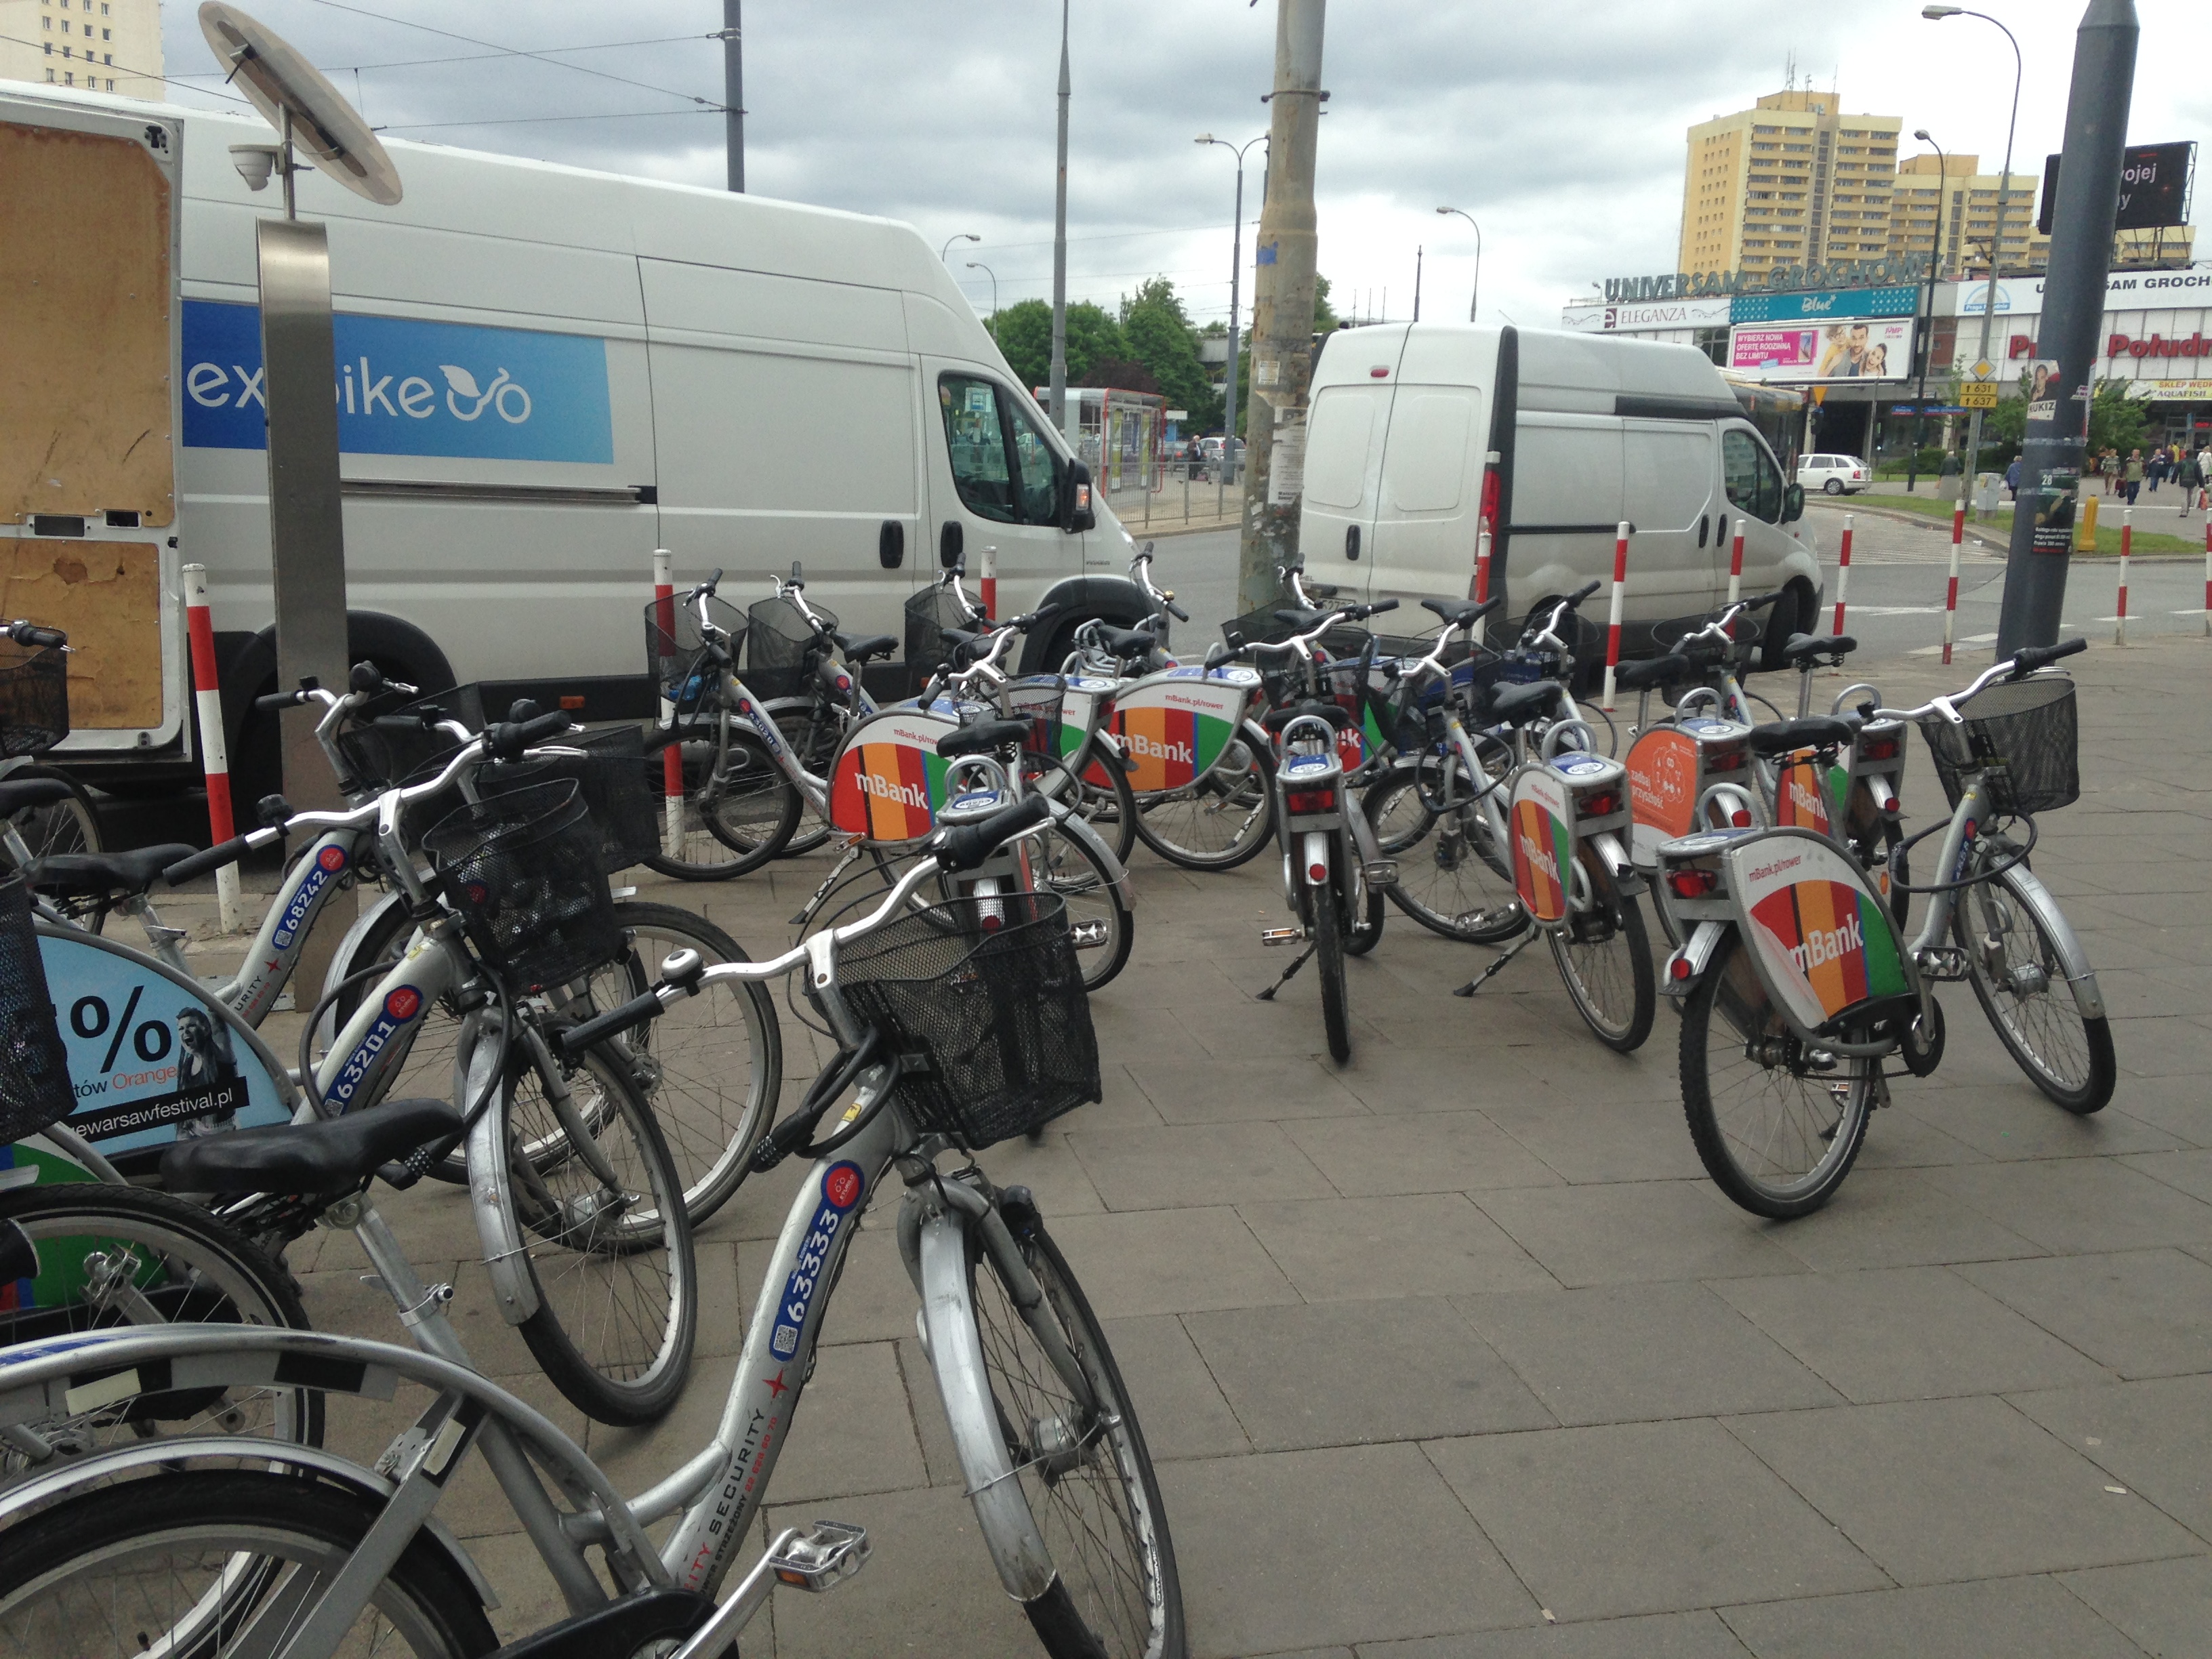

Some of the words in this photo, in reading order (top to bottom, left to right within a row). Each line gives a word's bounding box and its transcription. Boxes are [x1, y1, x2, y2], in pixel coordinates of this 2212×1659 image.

[1605, 270, 1748, 302] UNIVERSAM
[1621, 308, 1687, 323] ELEGANZA
[2042, 474, 2053, 485] 28
[1165, 695, 1224, 710] mBank.pl/rower
[1111, 733, 1193, 764] mBank
[855, 772, 929, 810] mBank
[1520, 834, 1561, 884] mBank
[1749, 855, 1801, 882] mBank.pl/rower
[285, 871, 327, 930] 68242
[1790, 913, 1863, 971] mBank
[234, 976, 262, 1010] URITY
[337, 1021, 396, 1098] 63201
[112, 1066, 178, 1090] Orange
[787, 1208, 838, 1322] 63333
[709, 1408, 764, 1535] SECURITY
[715, 1495, 747, 1562] STRZEŻONY
